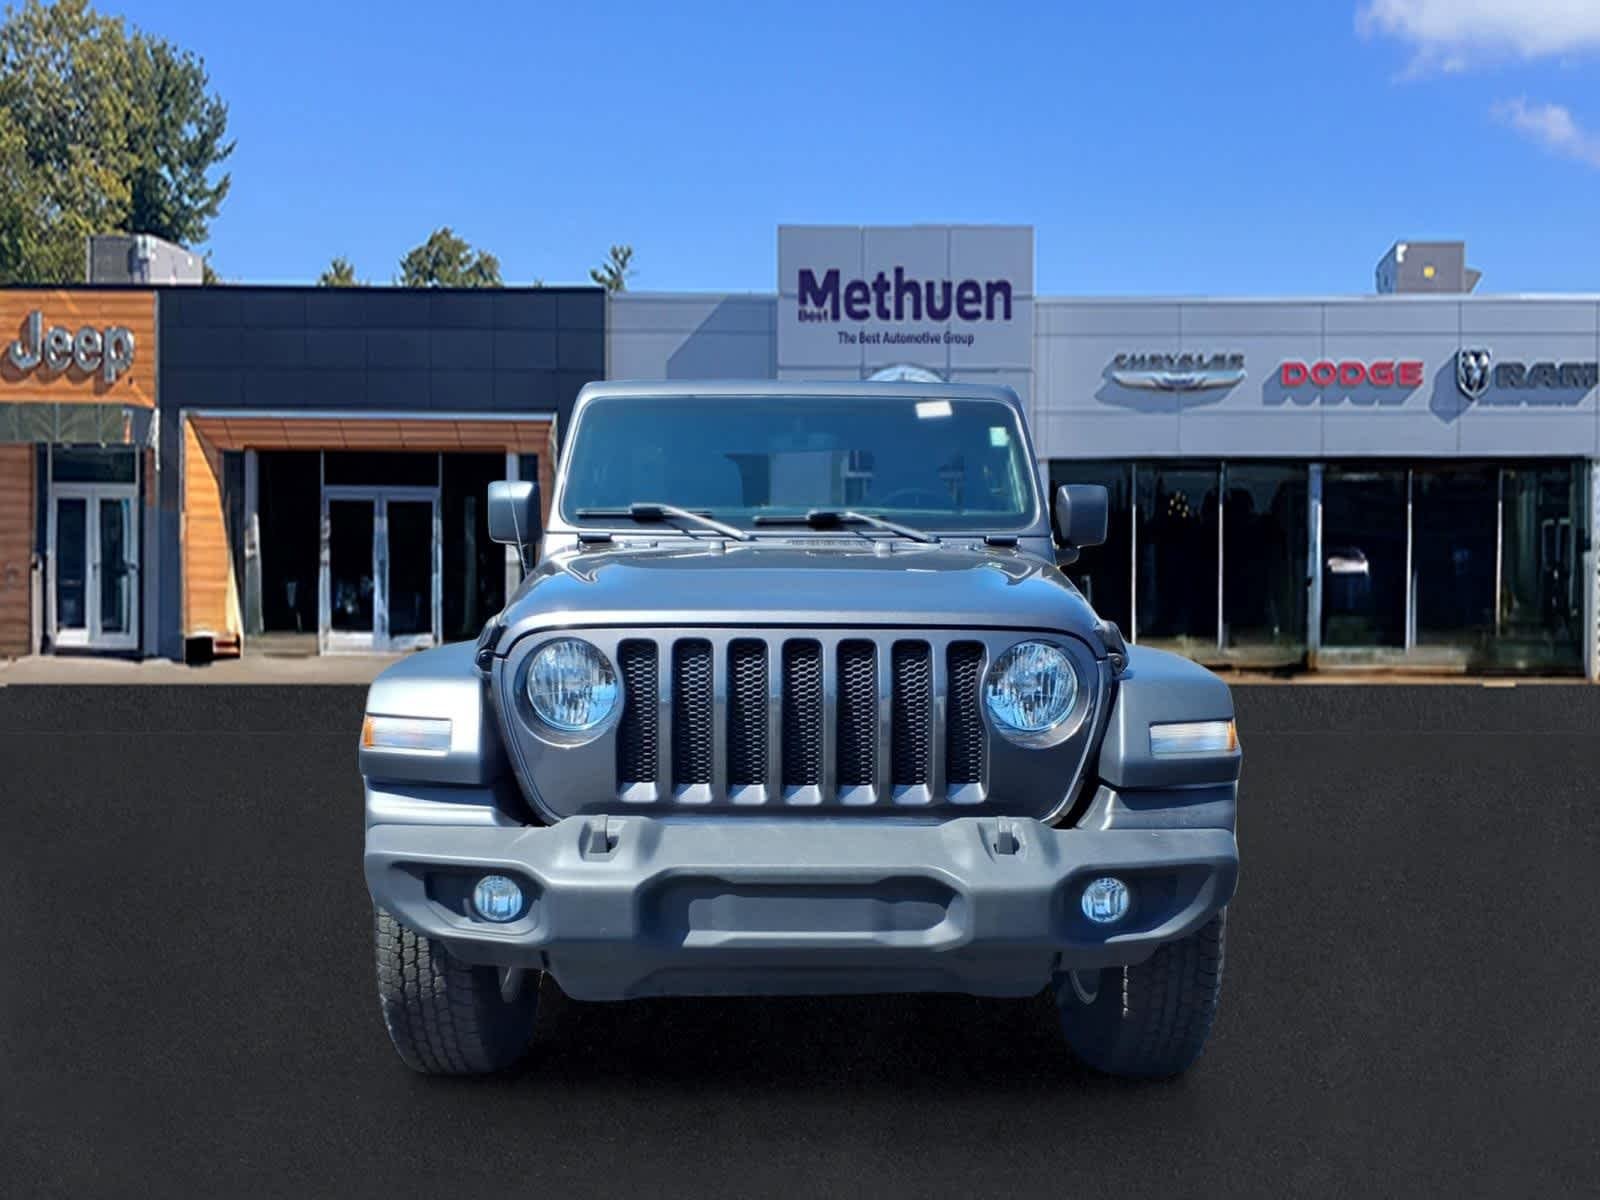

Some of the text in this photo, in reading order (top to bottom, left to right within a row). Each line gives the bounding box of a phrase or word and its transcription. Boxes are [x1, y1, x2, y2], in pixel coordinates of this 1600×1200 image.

[798, 266, 1012, 321] Methuen
[10, 311, 134, 383] Jeep
[838, 331, 974, 347] The Best Automotive Group
[1281, 362, 1423, 386] DODGE
[1496, 362, 1598, 388] RAM
